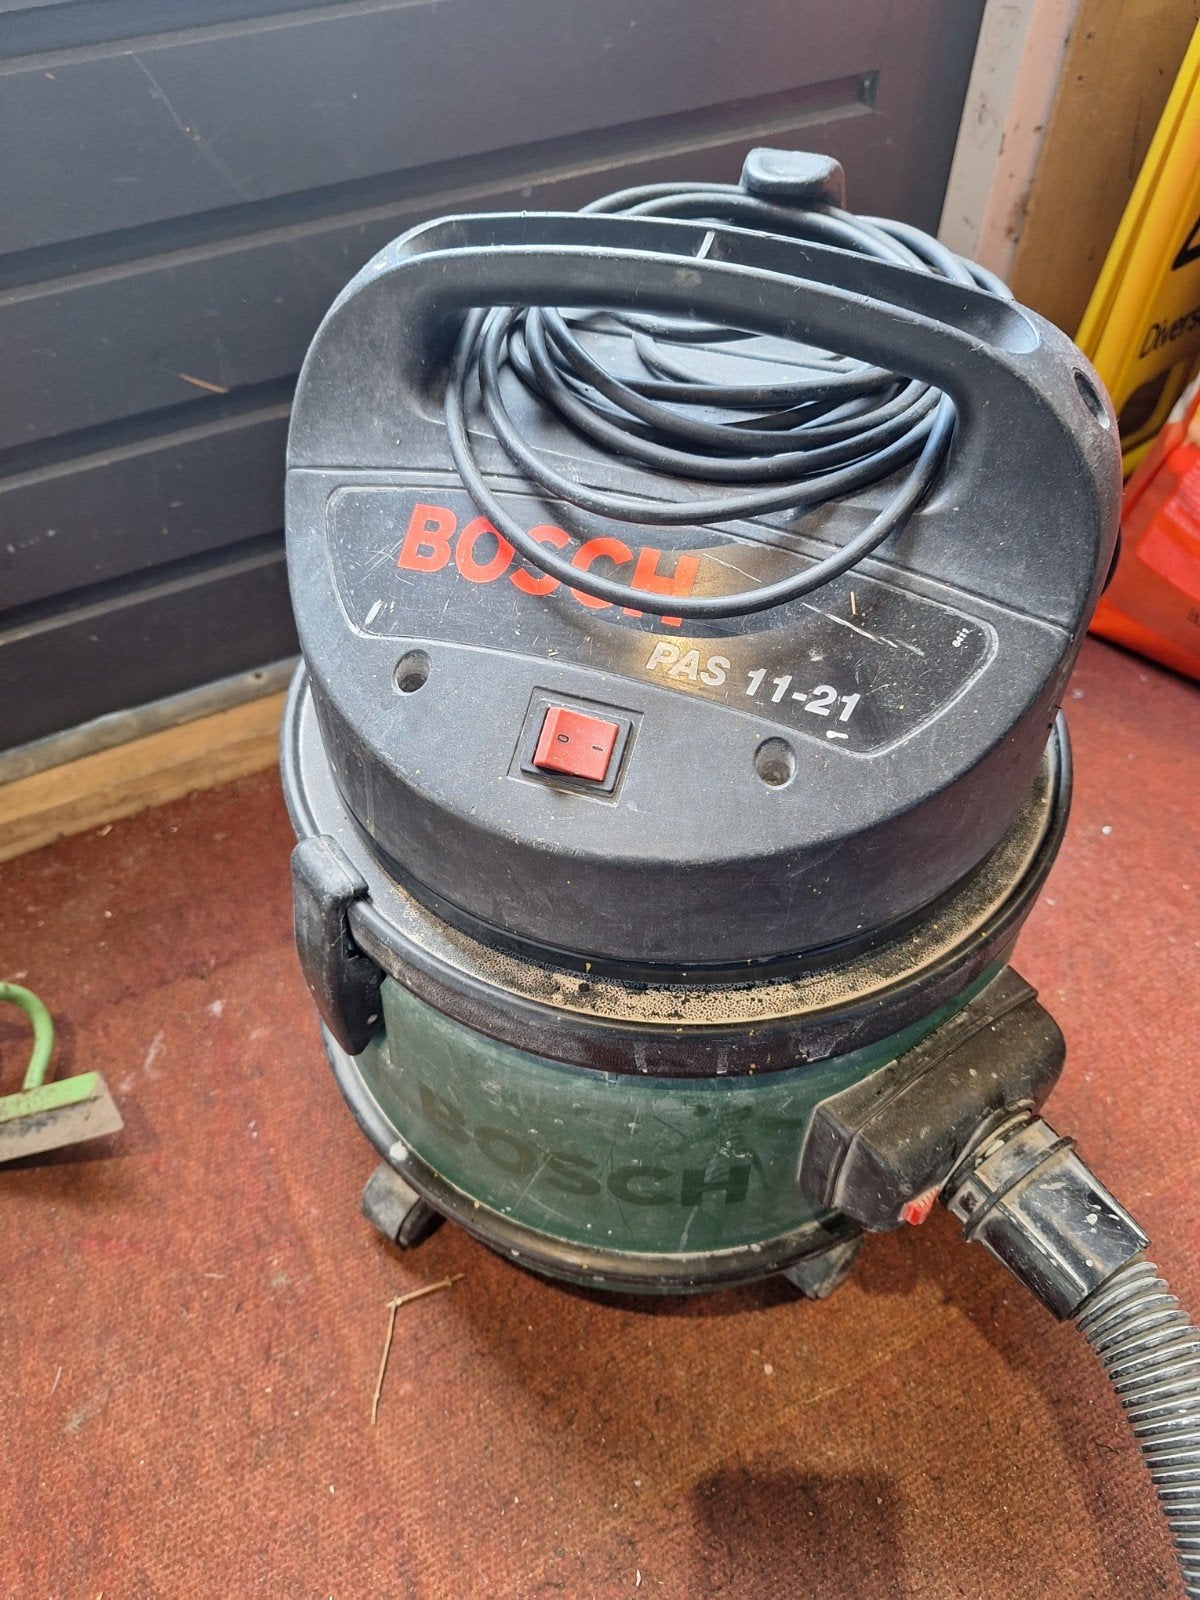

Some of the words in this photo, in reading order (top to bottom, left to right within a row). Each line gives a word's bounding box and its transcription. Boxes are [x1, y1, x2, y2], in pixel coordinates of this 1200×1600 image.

[397, 503, 701, 627] BOSCH
[645, 640, 731, 686] PAS
[746, 668, 861, 722] 11-21
[418, 1080, 752, 1208] BOSCH
